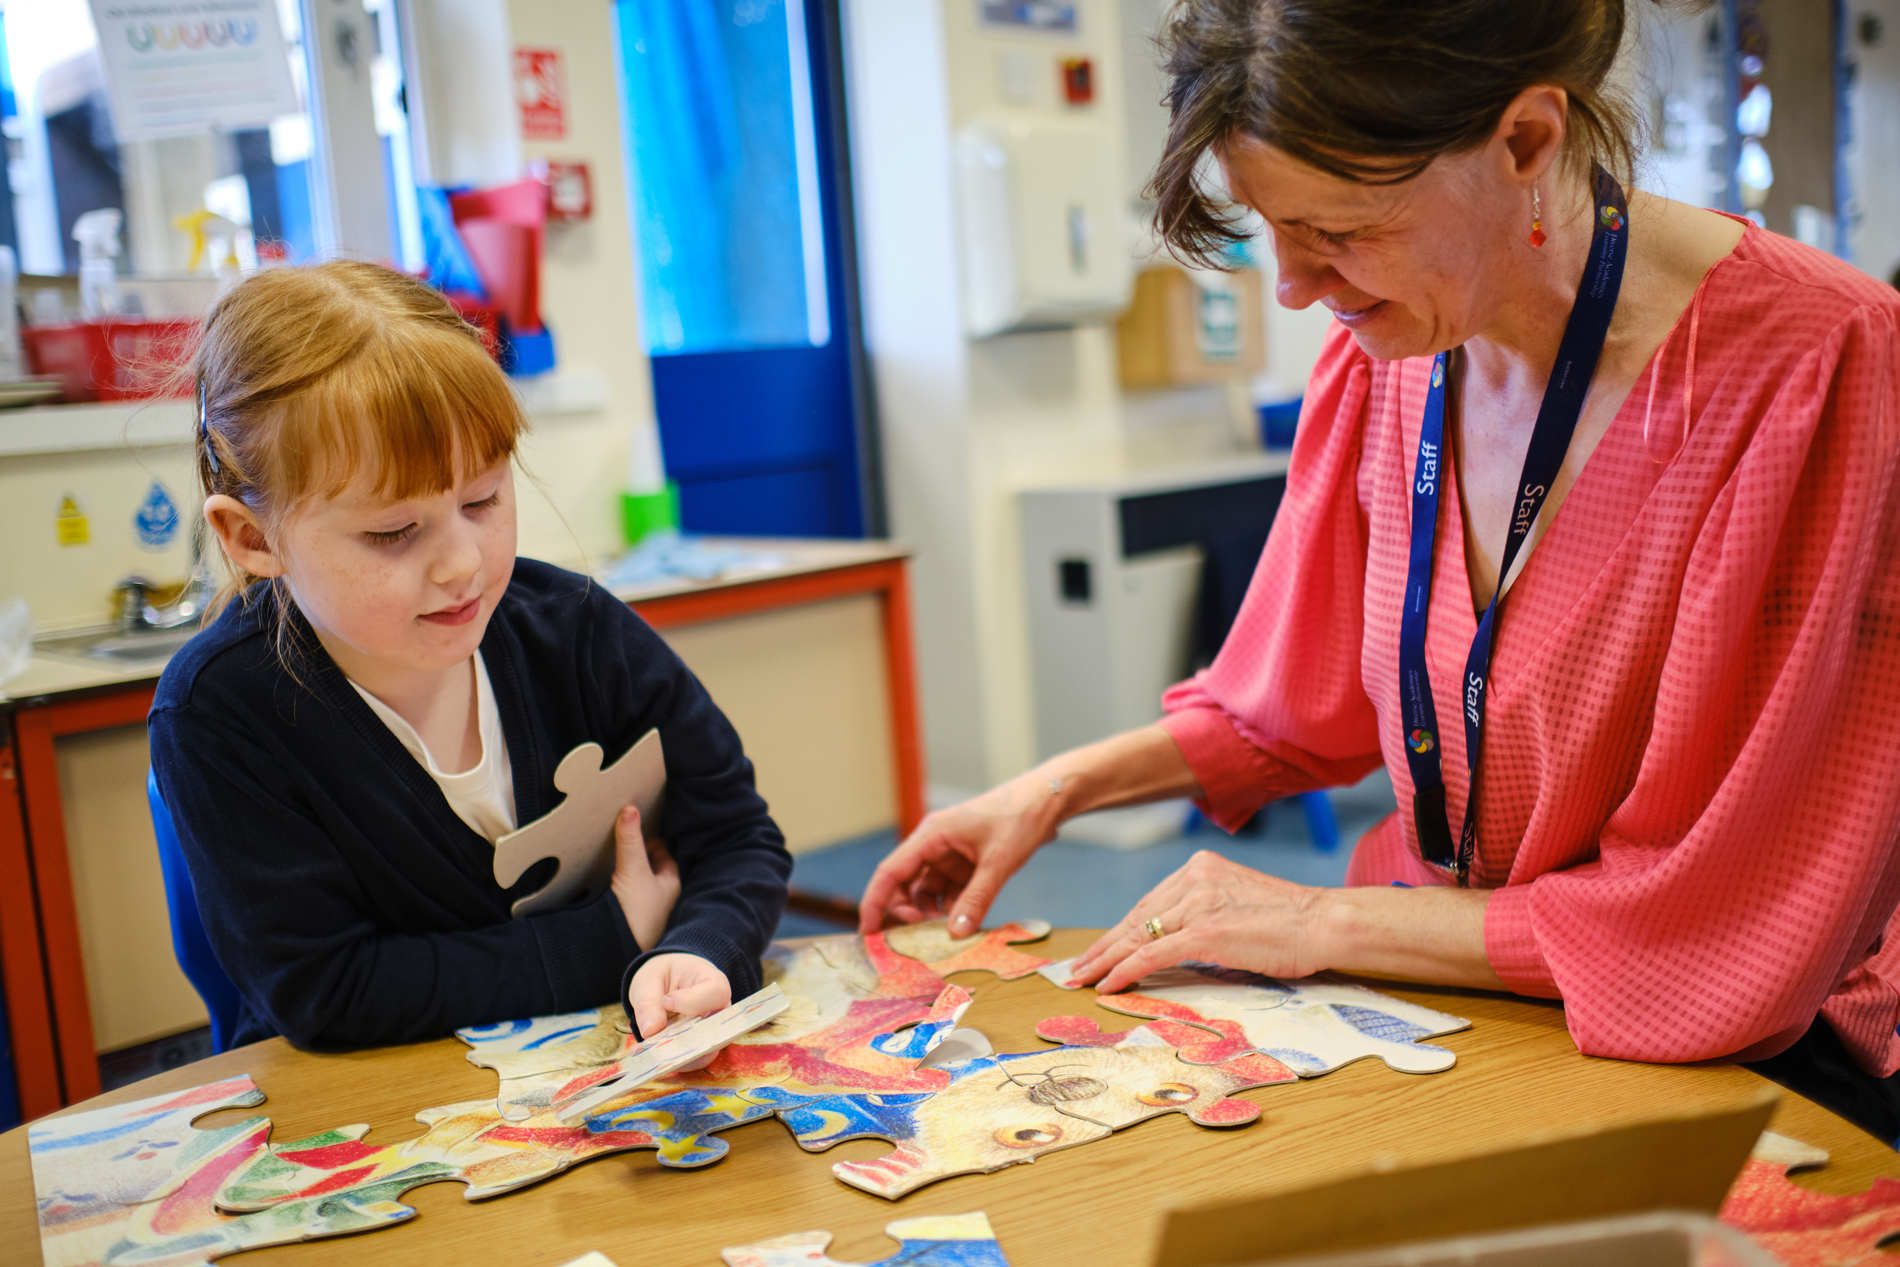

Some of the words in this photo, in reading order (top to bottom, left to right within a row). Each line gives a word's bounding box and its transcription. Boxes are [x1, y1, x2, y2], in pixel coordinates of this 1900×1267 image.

[1416, 440, 1438, 496] Staff
[1514, 483, 1545, 536] Staff
[1467, 671, 1484, 728] Staff
